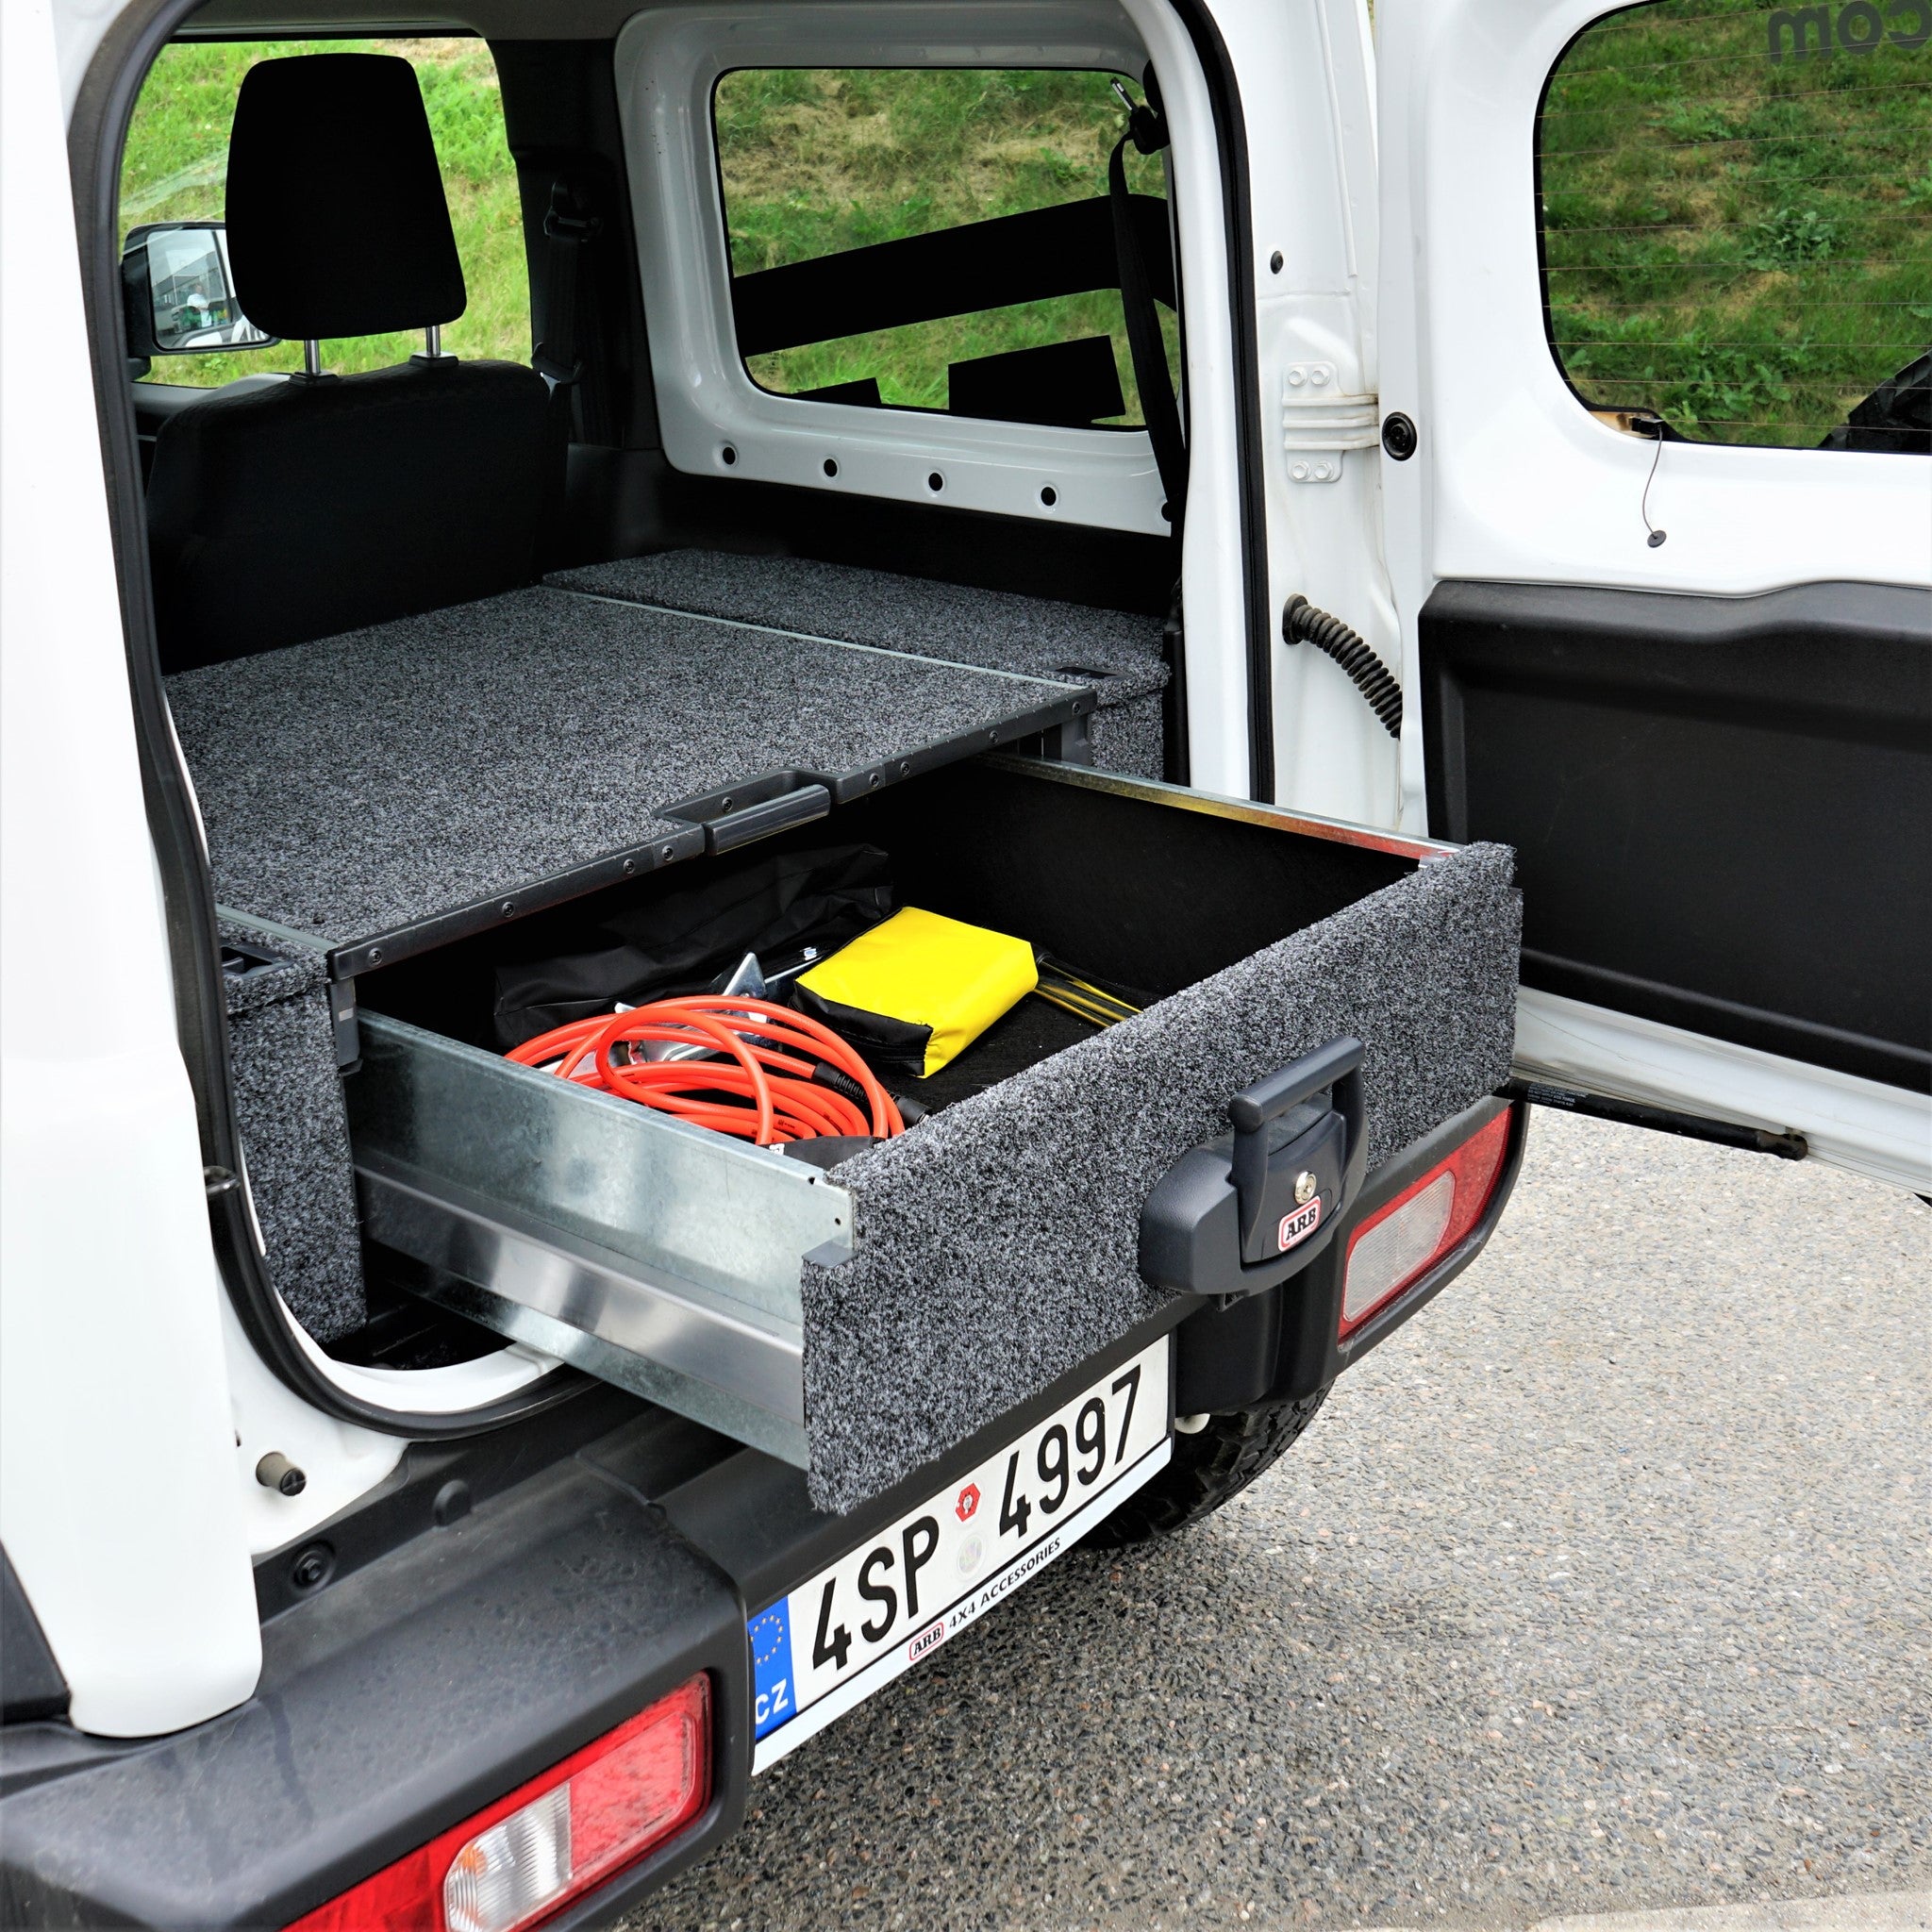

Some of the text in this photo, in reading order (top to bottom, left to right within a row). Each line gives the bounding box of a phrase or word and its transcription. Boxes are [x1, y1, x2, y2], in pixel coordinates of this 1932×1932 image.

[1286, 1208, 1317, 1241] ARB
[812, 1363, 1141, 1672] 4SP 4997
[913, 1537, 1060, 1657] ARB 4X4 ACCESSORIES
[755, 1677, 789, 1725] CZ
